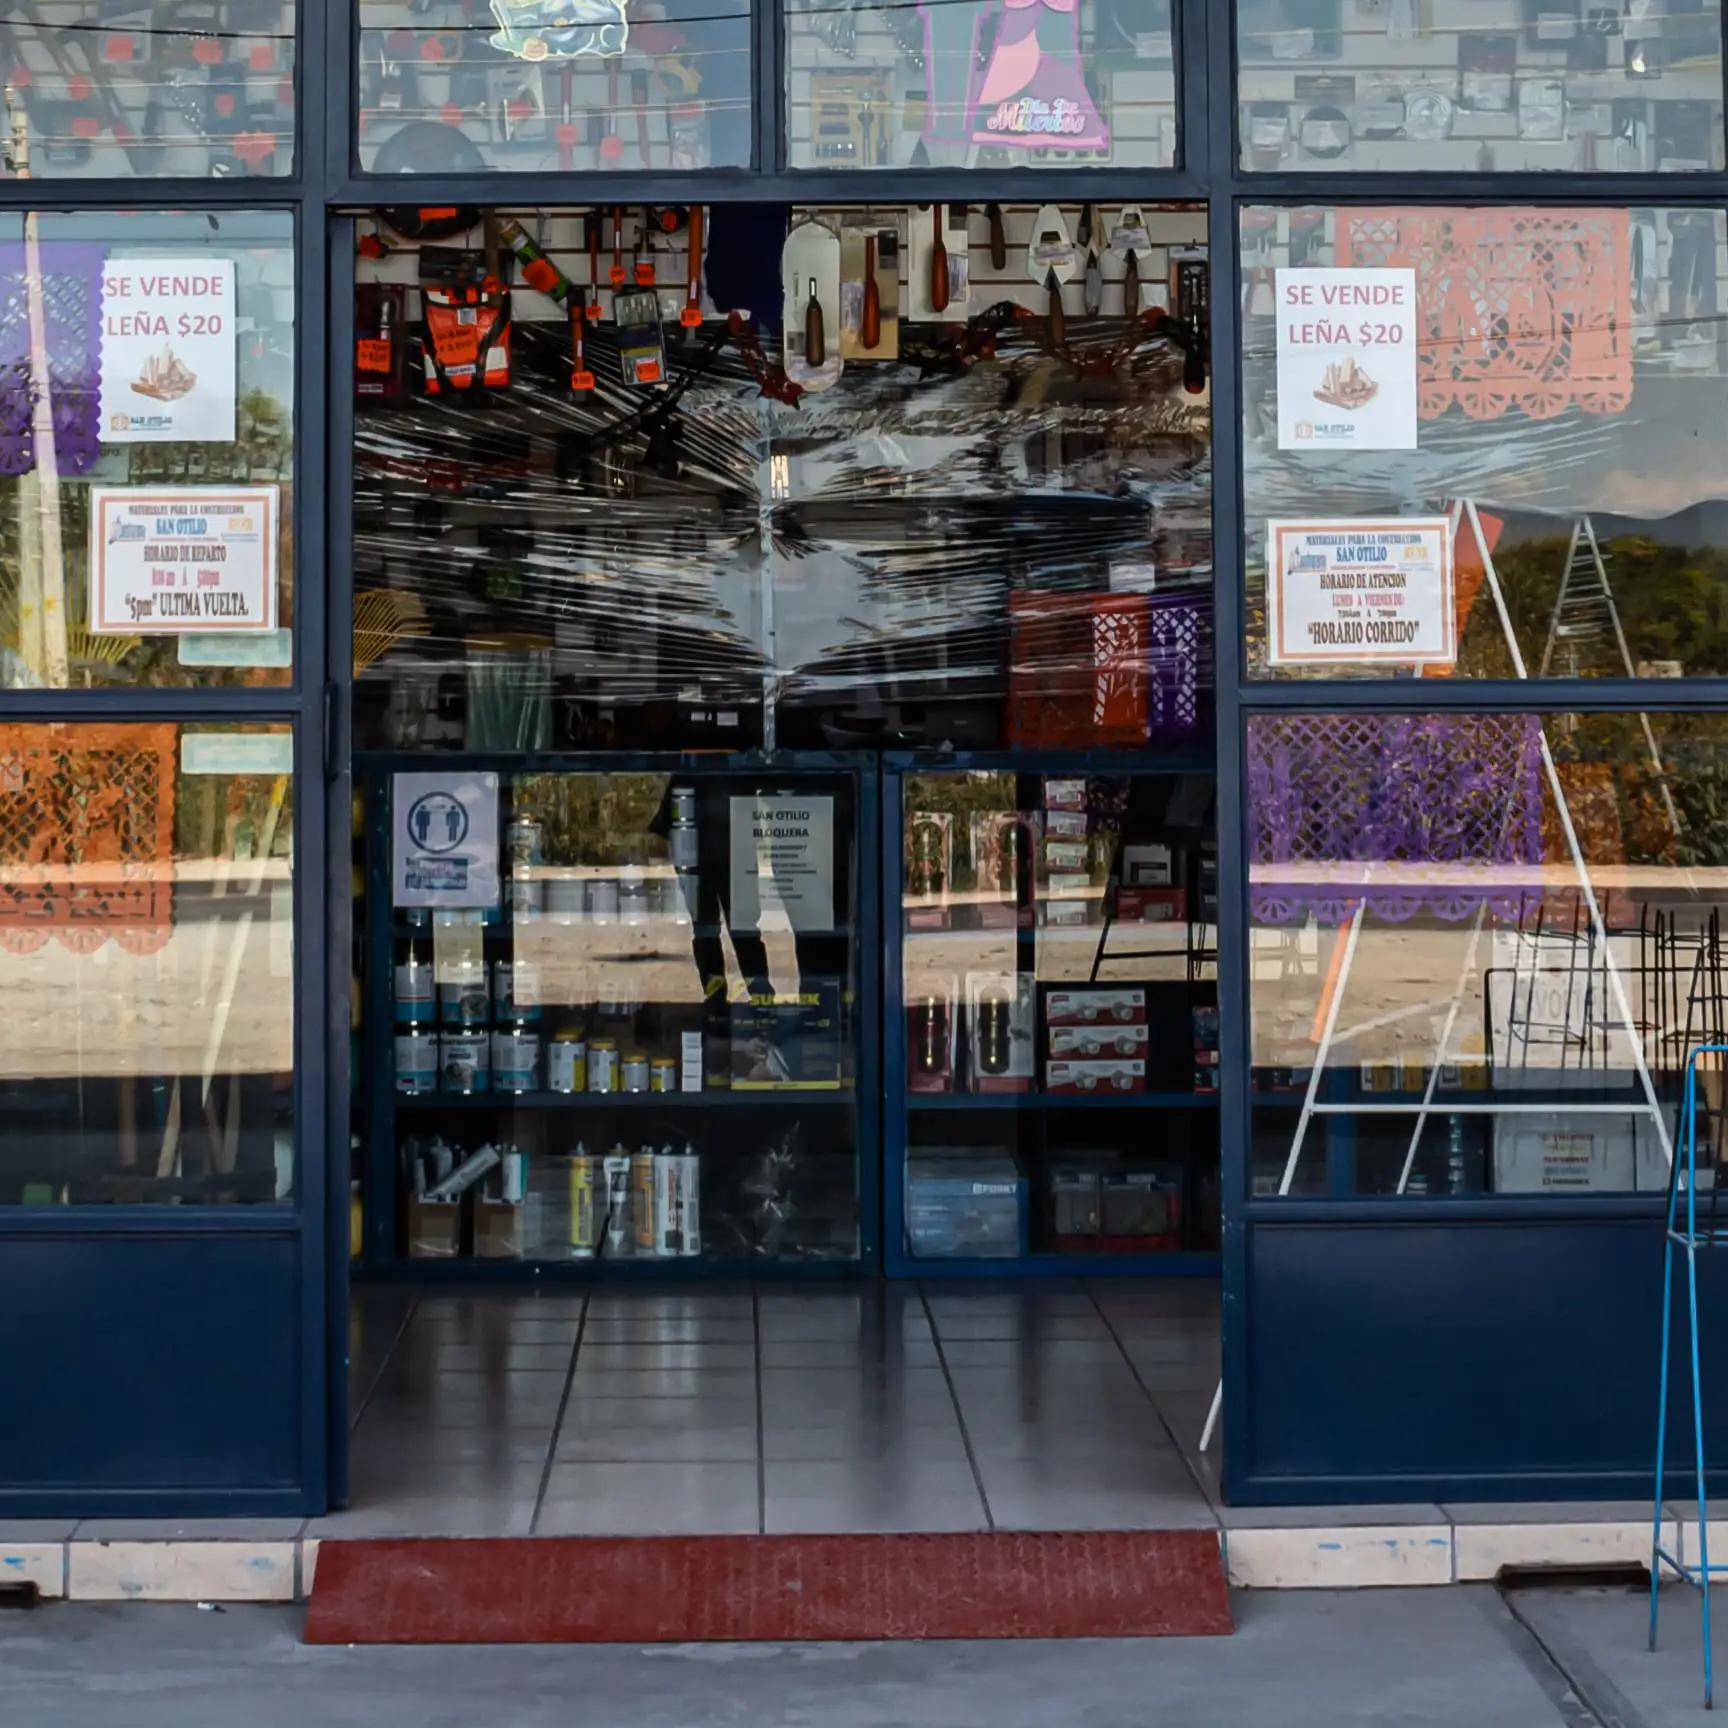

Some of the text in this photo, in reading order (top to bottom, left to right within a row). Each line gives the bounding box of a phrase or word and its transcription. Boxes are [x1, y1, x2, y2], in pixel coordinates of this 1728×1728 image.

[106, 277, 223, 297] SE VENDE
[1286, 285, 1404, 306] SE VENDE
[107, 311, 222, 337] LEÑA $20
[1289, 318, 1403, 345] LEÑA $20
[156, 518, 175, 535] SAN
[176, 518, 207, 535] OTILIO
[144, 545, 226, 562] HORARIO DE REPARTO
[1336, 547, 1355, 562] SAN
[1357, 546, 1388, 562] OTILIO
[1320, 573, 1407, 589] HORARIO DE ATENCION
[160, 592, 201, 616] ULTIMA
[776, 811, 810, 821] OTILIO
